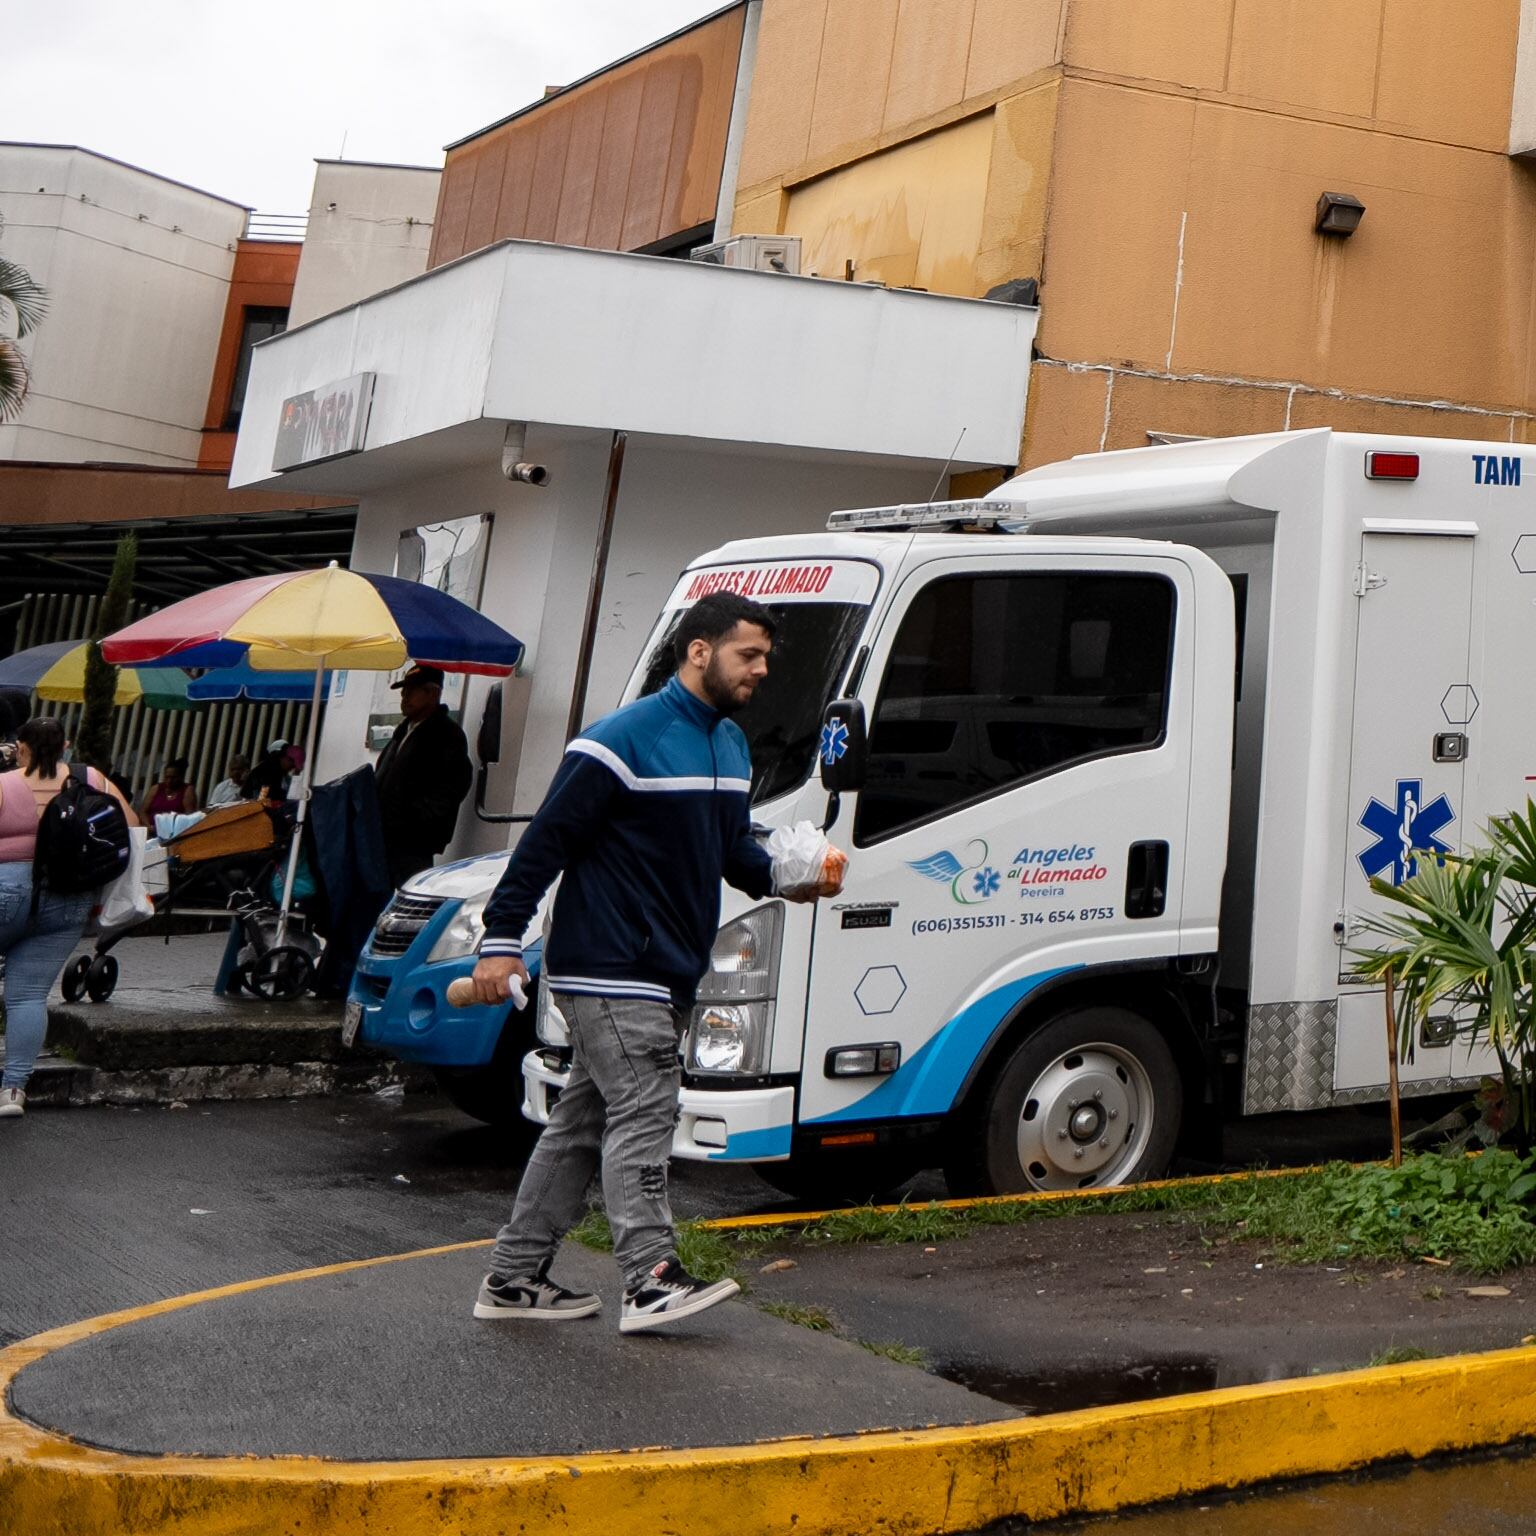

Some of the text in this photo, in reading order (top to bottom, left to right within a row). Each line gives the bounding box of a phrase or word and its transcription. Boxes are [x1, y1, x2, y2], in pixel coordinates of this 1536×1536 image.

[1472, 455, 1521, 486] TAM
[684, 565, 833, 601] ANGELES AL LLAMADO
[1013, 844, 1095, 866] Angeles
[1007, 864, 1107, 885] al Llamado
[1020, 886, 1065, 898] Pereira
[845, 915, 889, 927] ISUZU
[911, 914, 1006, 936] (606)3515311
[1020, 912, 1044, 926] 314
[1048, 910, 1075, 924] 654
[1079, 907, 1114, 920] 8753
